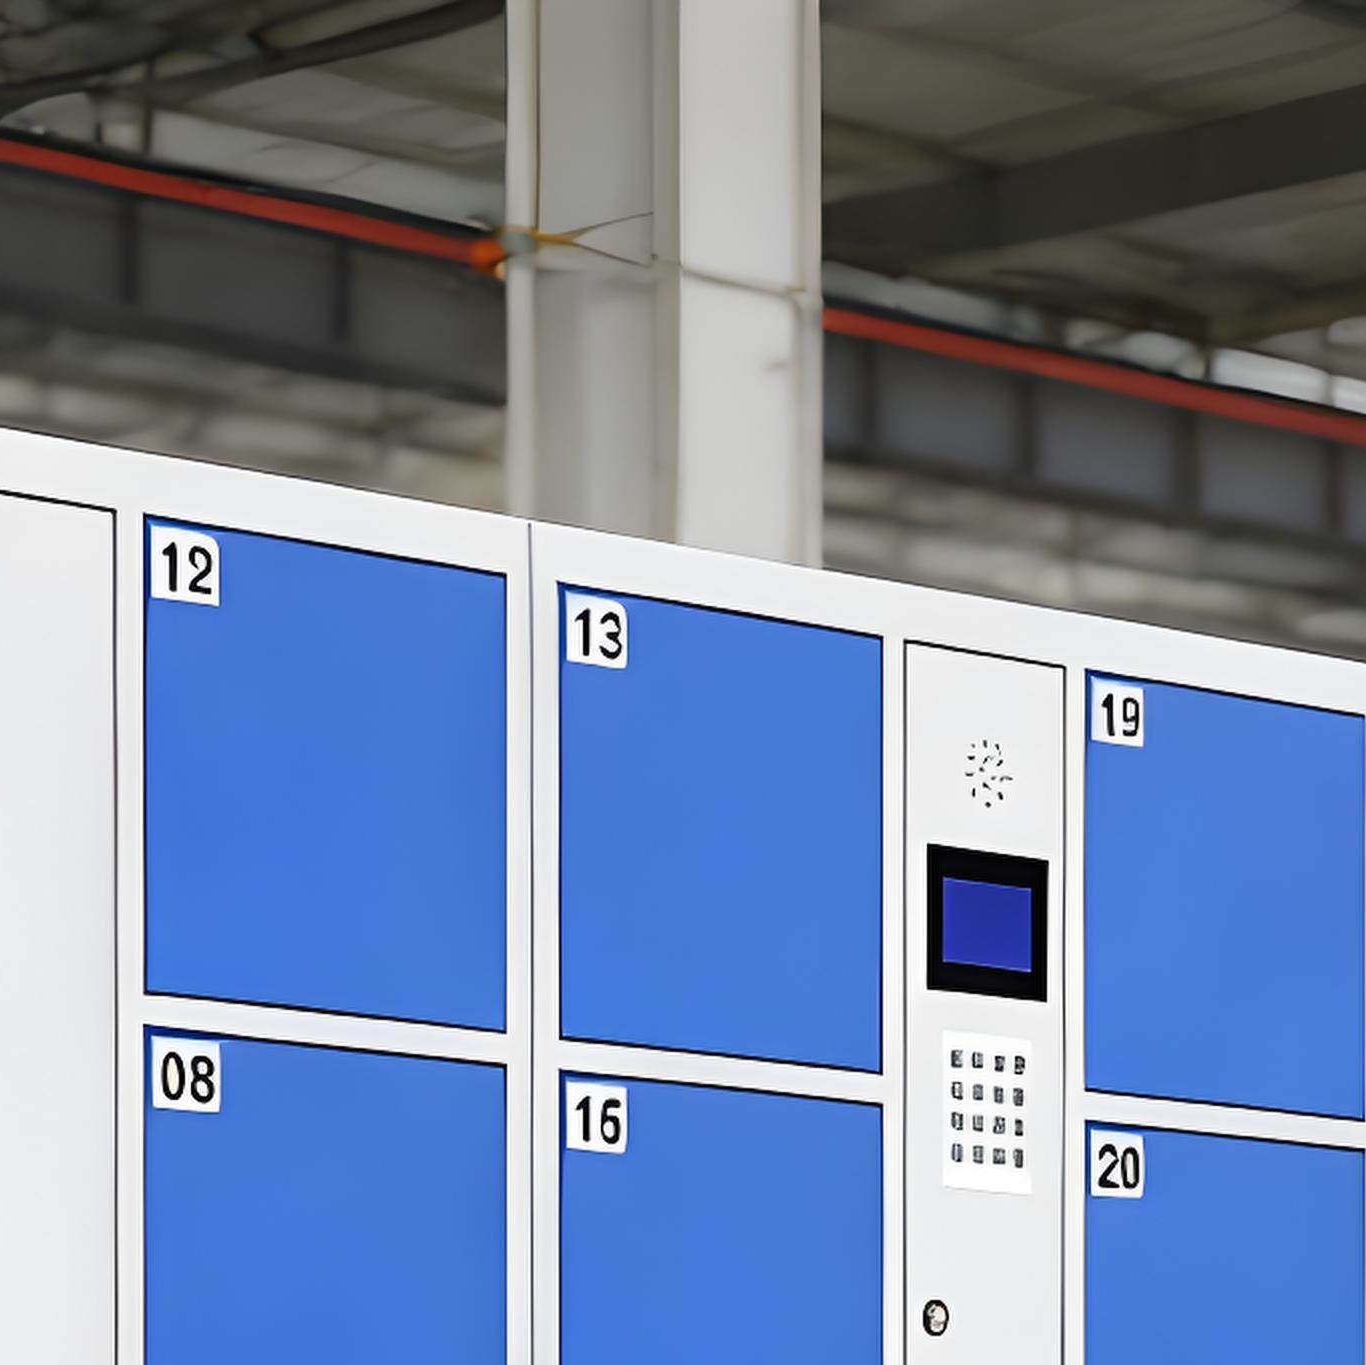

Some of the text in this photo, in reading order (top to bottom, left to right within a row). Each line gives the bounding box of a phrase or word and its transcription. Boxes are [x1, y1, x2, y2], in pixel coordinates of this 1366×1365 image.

[162, 540, 213, 595] 12
[575, 608, 623, 660] 13
[1101, 693, 1140, 737] 19
[161, 1051, 215, 1104] 08
[575, 1095, 621, 1145] 16
[1098, 1143, 1140, 1189] 20
